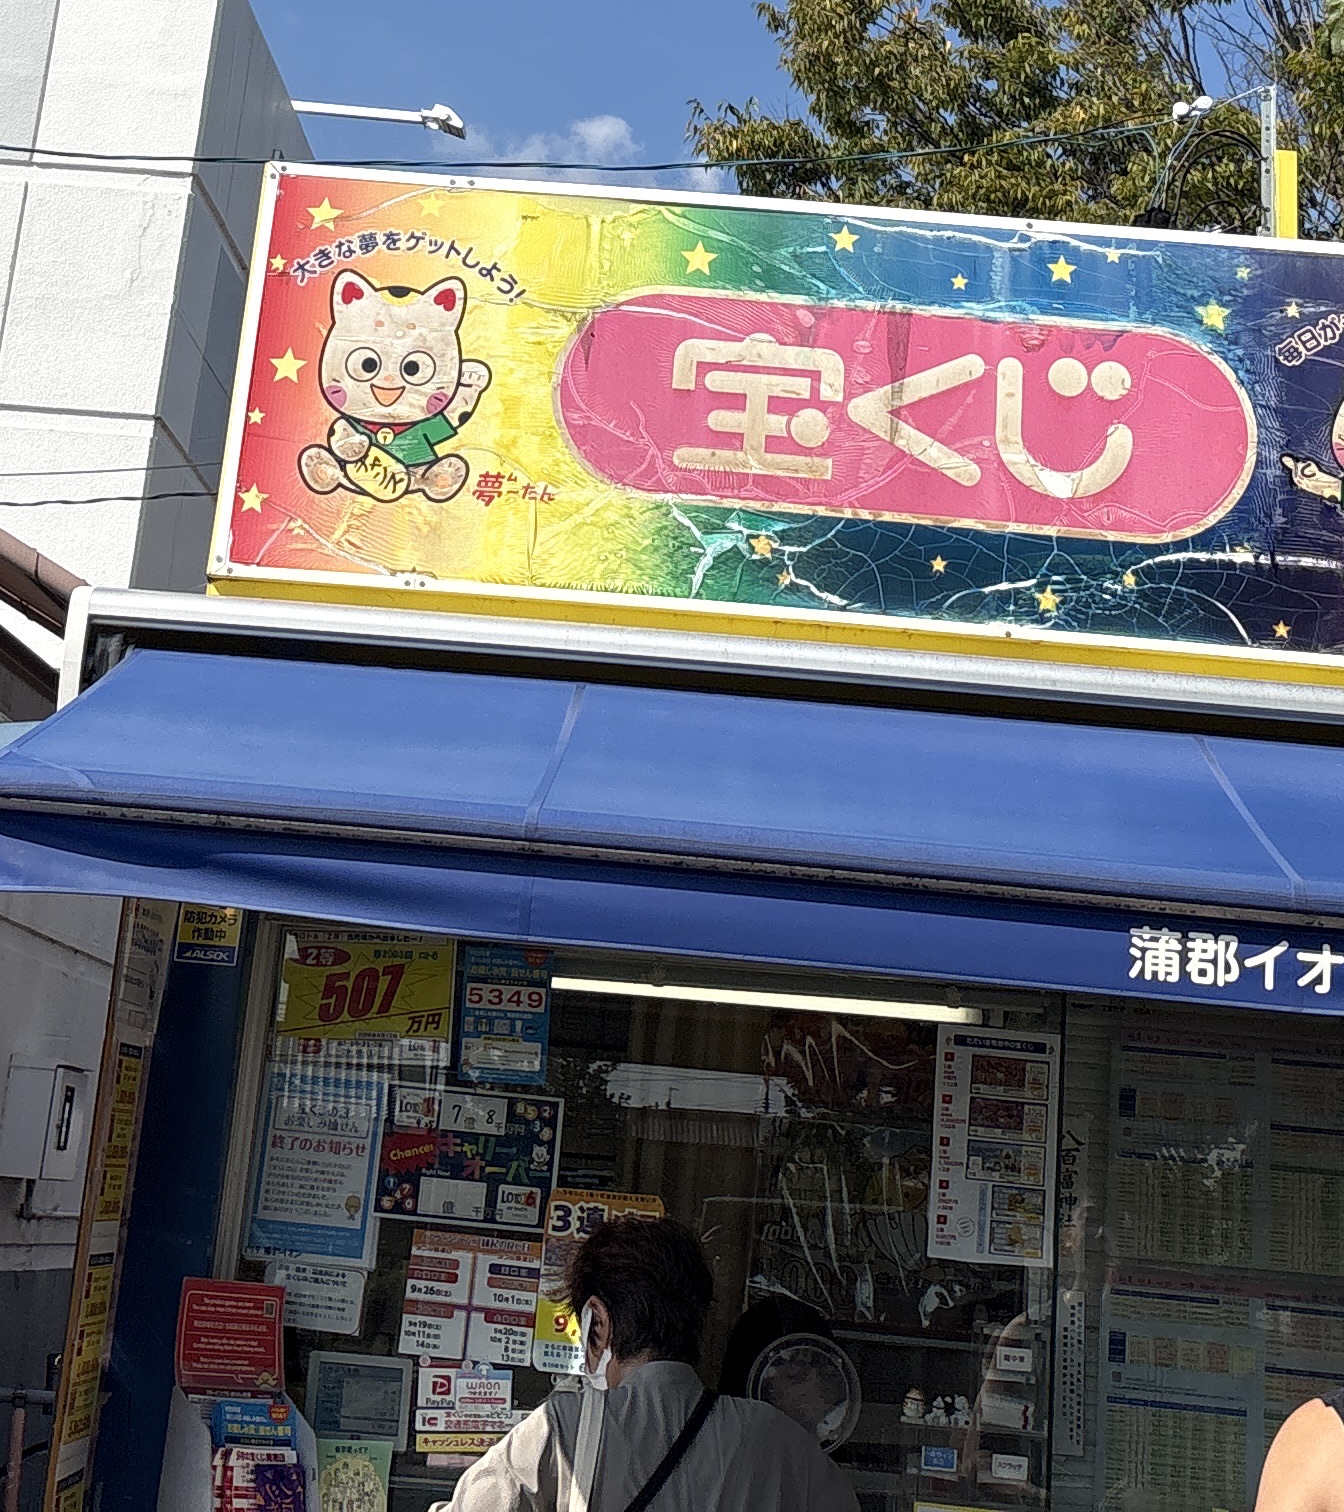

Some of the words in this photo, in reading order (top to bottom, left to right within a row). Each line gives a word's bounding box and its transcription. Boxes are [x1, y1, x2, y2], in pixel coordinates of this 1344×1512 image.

[292, 231, 527, 304] 大きな夢をゲットしよう!
[672, 333, 1134, 498] 宝くじ
[183, 909, 239, 926] 防犯カメラ
[191, 927, 227, 942] 作動中
[191, 948, 230, 961] ALSOK
[305, 947, 336, 966] 2等
[318, 963, 406, 1023] 507
[467, 987, 544, 1009] 5349
[407, 1012, 443, 1035] 万円
[270, 1134, 367, 1157] 終了のお知らせ
[439, 1131, 518, 1162] キャリー
[460, 1155, 551, 1185] オーバー
[425, 1397, 455, 1408] PayPay
[422, 1436, 503, 1448] キャッシュレス決済
